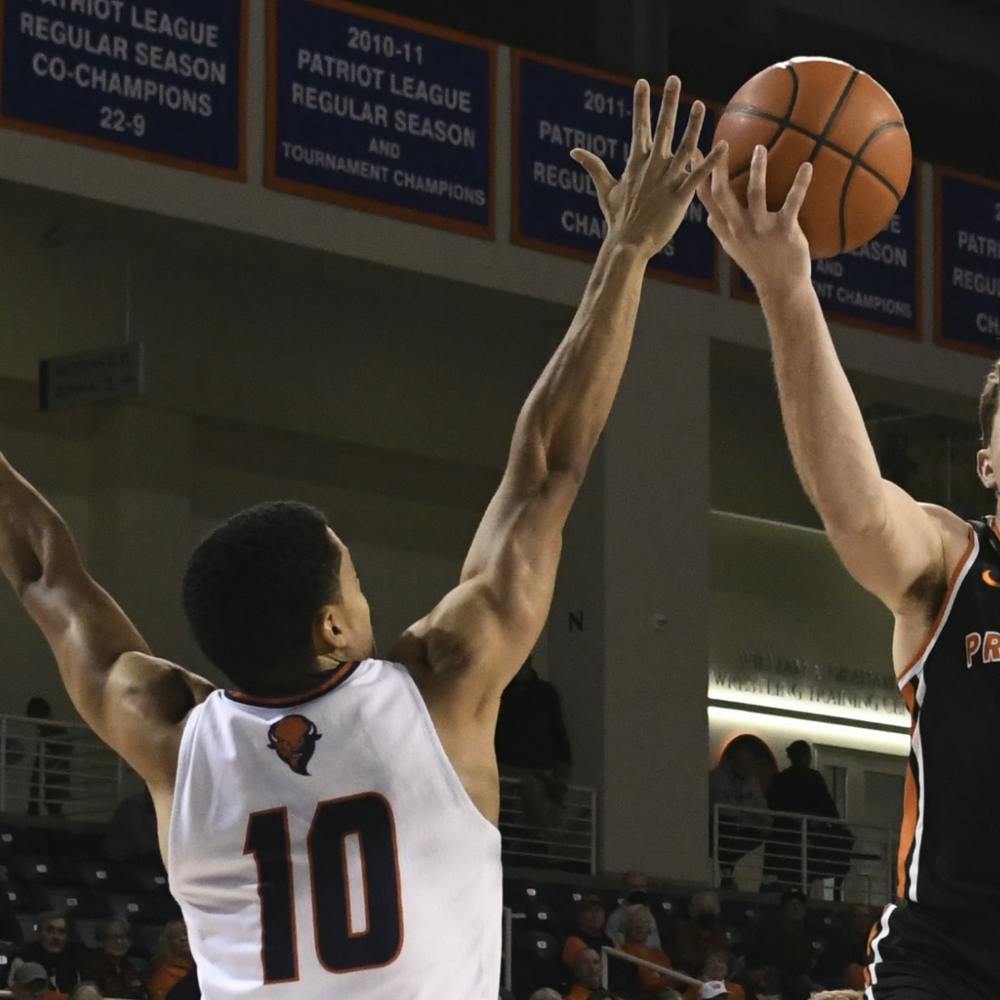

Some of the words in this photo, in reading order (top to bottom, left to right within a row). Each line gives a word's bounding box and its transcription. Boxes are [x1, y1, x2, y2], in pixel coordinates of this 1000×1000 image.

[20, 11, 129, 62] REGULAR
[134, 41, 227, 85] SEASON
[30, 0, 124, 23] RIOT
[131, 5, 220, 48] LEAGUE
[347, 26, 423, 65] 2010-11
[32, 51, 213, 117] CO-CHAMPIONS
[297, 48, 385, 91] PATRIOT
[390, 73, 473, 114] LEAGUE
[99, 105, 146, 137] 22-9
[291, 81, 389, 128] REGULAR
[394, 109, 476, 149] SEASON
[281, 140, 390, 183] TOURNAMENT
[393, 168, 487, 207] CHAMPIONS
[367, 137, 401, 160] AND
[836, 284, 912, 319] CHAMPIONS
[243, 791, 404, 985] 10
